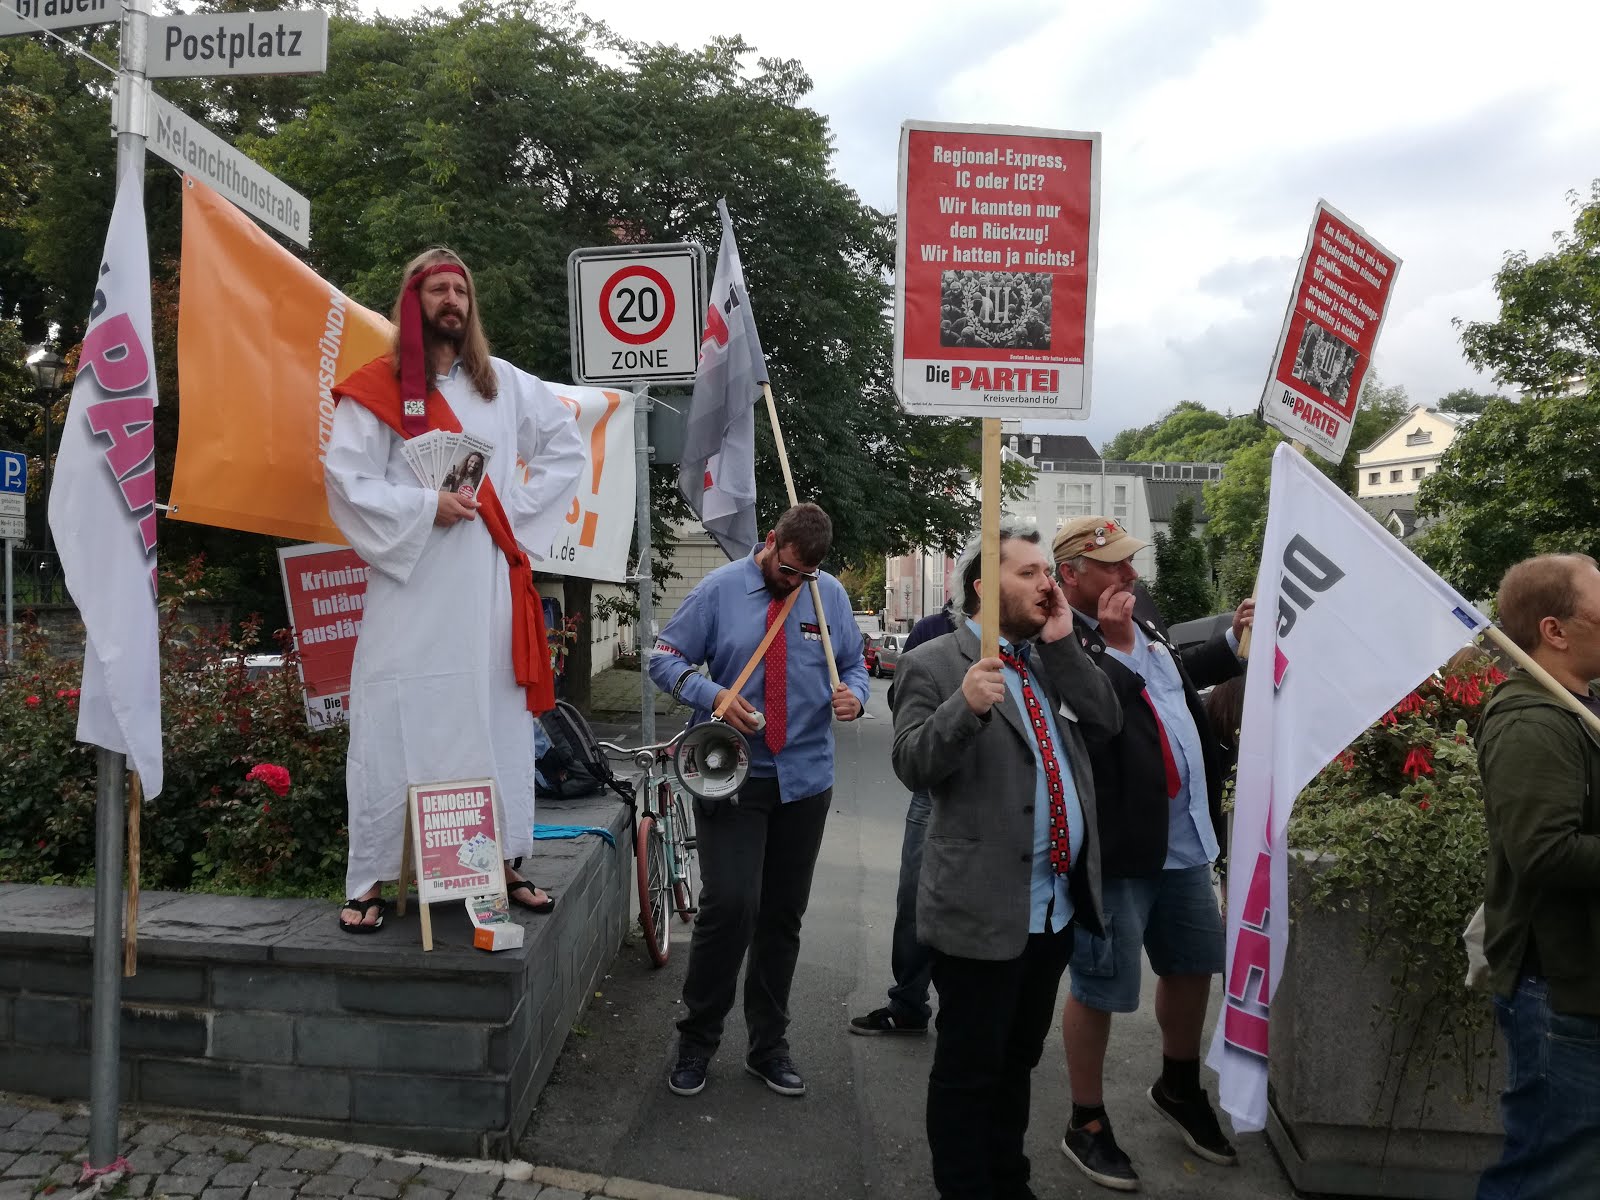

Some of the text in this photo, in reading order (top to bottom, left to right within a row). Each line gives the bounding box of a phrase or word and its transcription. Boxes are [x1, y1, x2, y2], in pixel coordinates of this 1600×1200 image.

[165, 23, 303, 68] Postplatz
[933, 145, 1067, 171] Regional-Express,
[156, 113, 300, 232] Melanchthonstraße
[956, 170, 1045, 191] IC oder ICE?
[939, 196, 1062, 218] Wir kannten nur
[950, 221, 1049, 245] den Rückzug!
[1324, 222, 1335, 237] Am
[1335, 229, 1355, 253] Anfang
[1356, 244, 1366, 259] hat
[920, 244, 1075, 268] Wir hatten ja nichts!
[1316, 254, 1343, 279] geholfen.
[1321, 236, 1382, 290] Wiederaufbau niemand
[1309, 284, 1333, 306] arbeiter
[1332, 299, 1339, 311] ja
[1313, 267, 1325, 283] Wir
[1349, 290, 1358, 306] die
[616, 287, 658, 323] 20
[1305, 298, 1360, 343] Wir hatten ja nichts!
[611, 349, 669, 370] ZONE
[926, 364, 1060, 393] Die PARTEI
[404, 407, 425, 416] NZS
[983, 394, 1059, 405] Kreisverband Hof
[1282, 390, 1295, 408] Die
[1293, 397, 1341, 440] PARTEI
[5, 457, 21, 487] P
[324, 697, 341, 710] Die
[422, 791, 489, 813] DEMOGELD-
[424, 809, 486, 831] ANNAHME-
[425, 828, 465, 849] STELLE
[433, 880, 444, 889] Die
[444, 874, 490, 890] PARTEI
